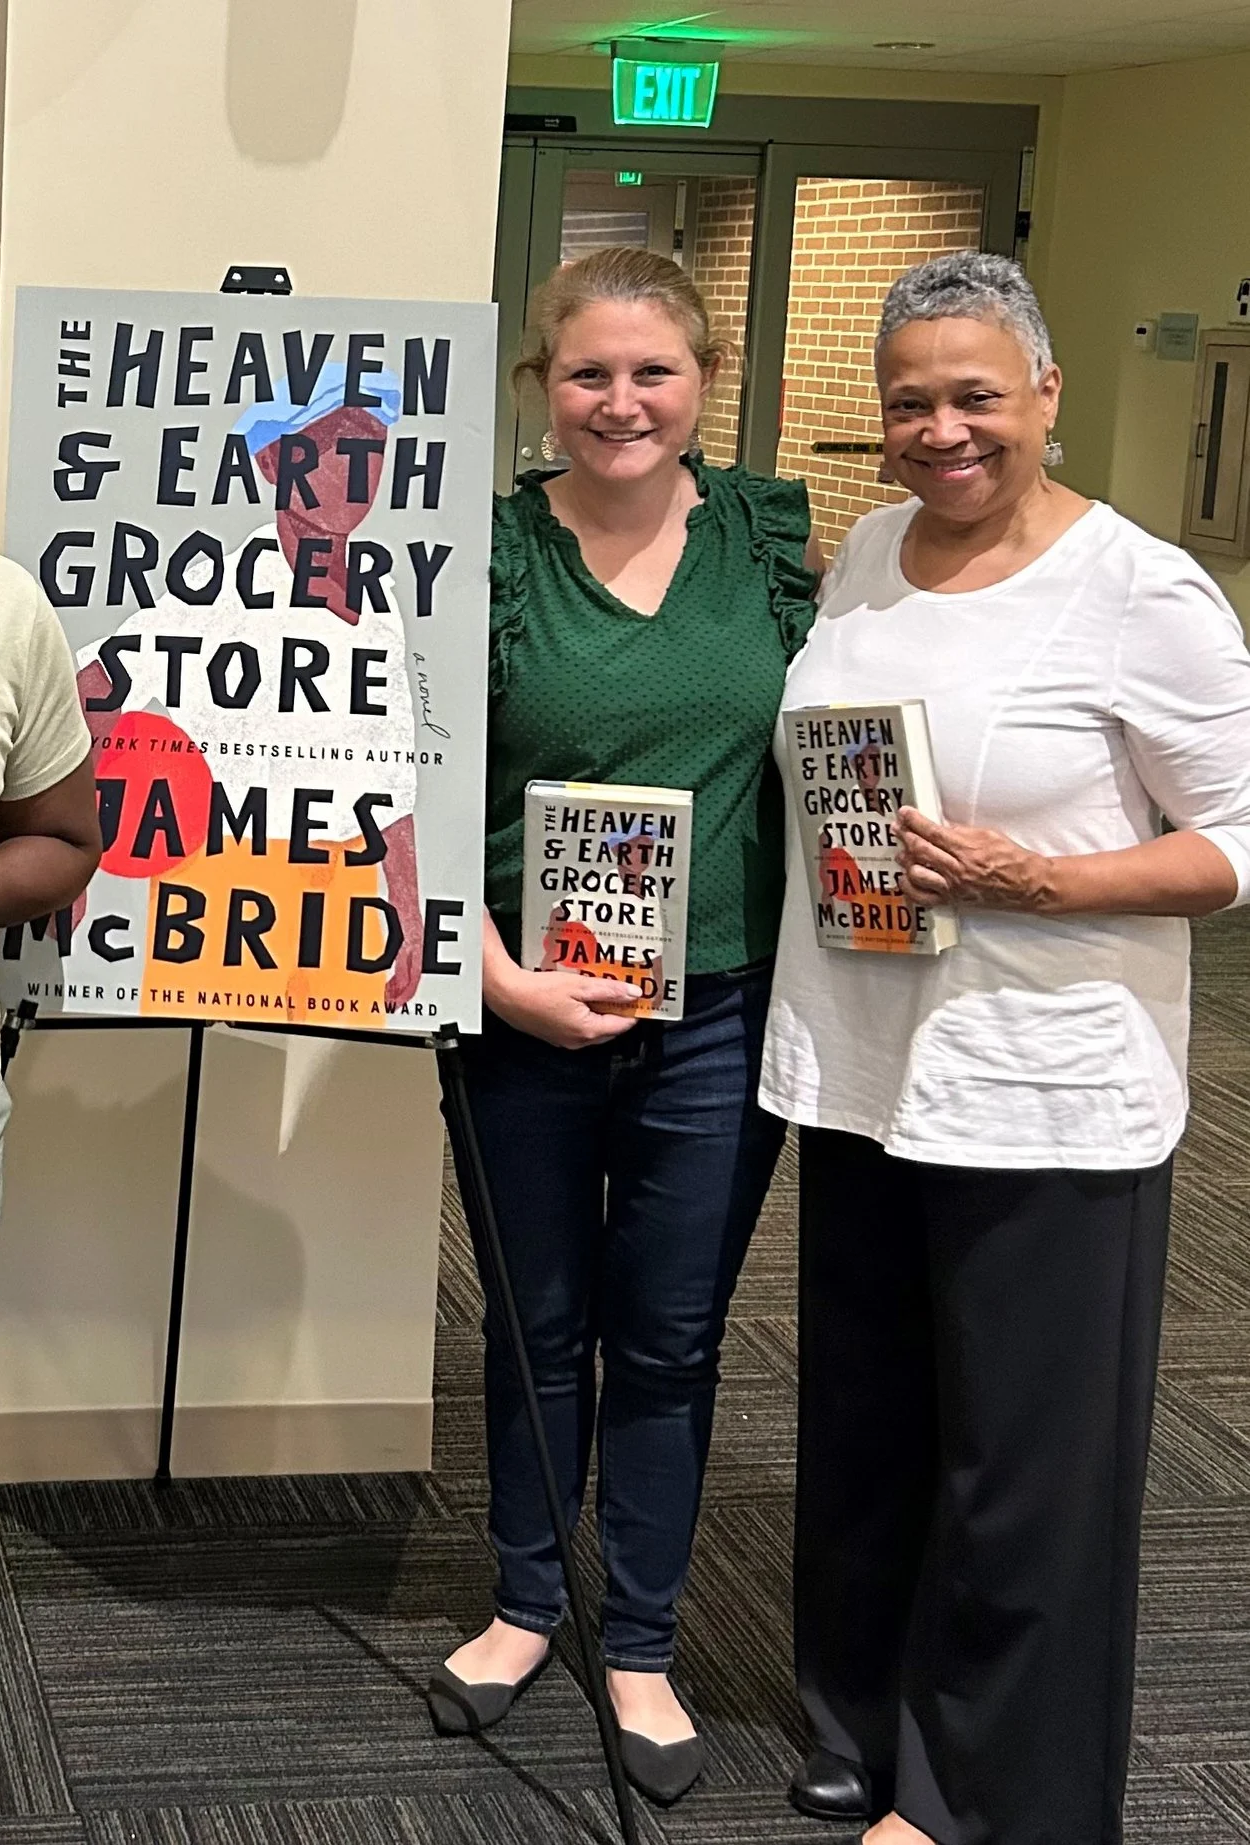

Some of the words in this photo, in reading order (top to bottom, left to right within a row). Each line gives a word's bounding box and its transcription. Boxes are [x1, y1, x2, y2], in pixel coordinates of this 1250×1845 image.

[633, 66, 701, 121] EXIT
[56, 320, 92, 408] THE
[106, 322, 451, 416] HEAVEN
[53, 431, 120, 501] &
[156, 426, 447, 511] EARTH
[39, 521, 454, 617] GROCERY
[412, 652, 426, 666] a
[85, 633, 389, 717] STORE
[417, 672, 451, 739] novel
[808, 718, 894, 749] HEAVEN
[91, 736, 140, 751] YORK
[150, 738, 209, 754] TIMES
[220, 743, 354, 761] BESTSELLING
[366, 749, 443, 765] AUTHOR
[802, 757, 818, 780] &
[826, 752, 898, 780] EARTH
[804, 786, 904, 815] GROCERY
[545, 805, 556, 832] THE
[561, 806, 676, 839] HEAVEN
[822, 822, 897, 849] STORE
[544, 839, 566, 860] &
[578, 838, 673, 867] EARTH
[540, 866, 676, 899] GROCERY
[827, 869, 904, 897] JAMES
[556, 899, 655, 927] STORE
[818, 903, 928, 932] McBRIDE
[553, 939, 656, 970] JAMES
[27, 982, 104, 999] WINNER
[116, 987, 139, 1000] OF
[150, 988, 185, 1003] THE
[198, 991, 296, 1009] NATIONAL
[308, 997, 359, 1012] BOOK
[371, 1000, 438, 1016] AWARD
